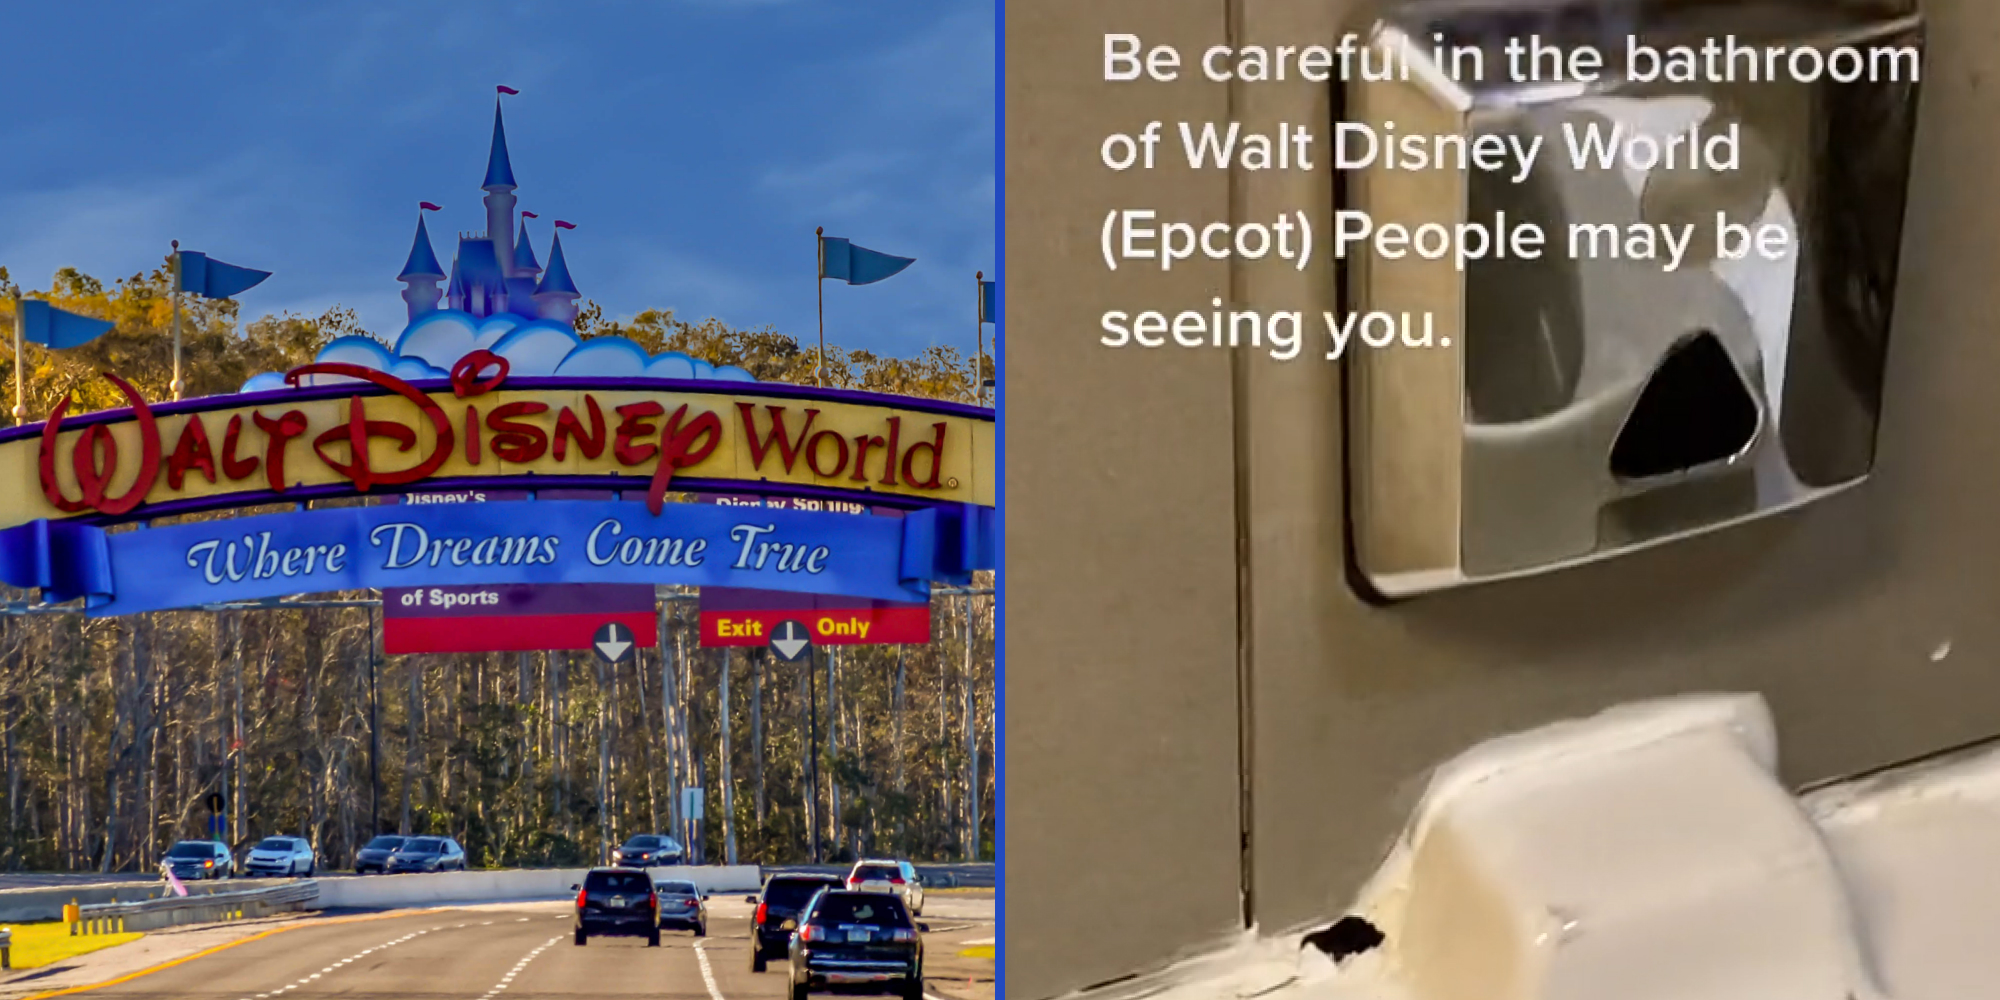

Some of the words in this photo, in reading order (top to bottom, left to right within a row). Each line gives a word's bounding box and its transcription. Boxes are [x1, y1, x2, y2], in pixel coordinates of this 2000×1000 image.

[187, 530, 346, 584] Where
[371, 522, 559, 569] Dreams
[586, 519, 707, 567] Come
[730, 523, 829, 574] True
[401, 588, 424, 606] of
[429, 588, 499, 609] Sports
[717, 619, 763, 637] Exit
[817, 617, 870, 639] Only
